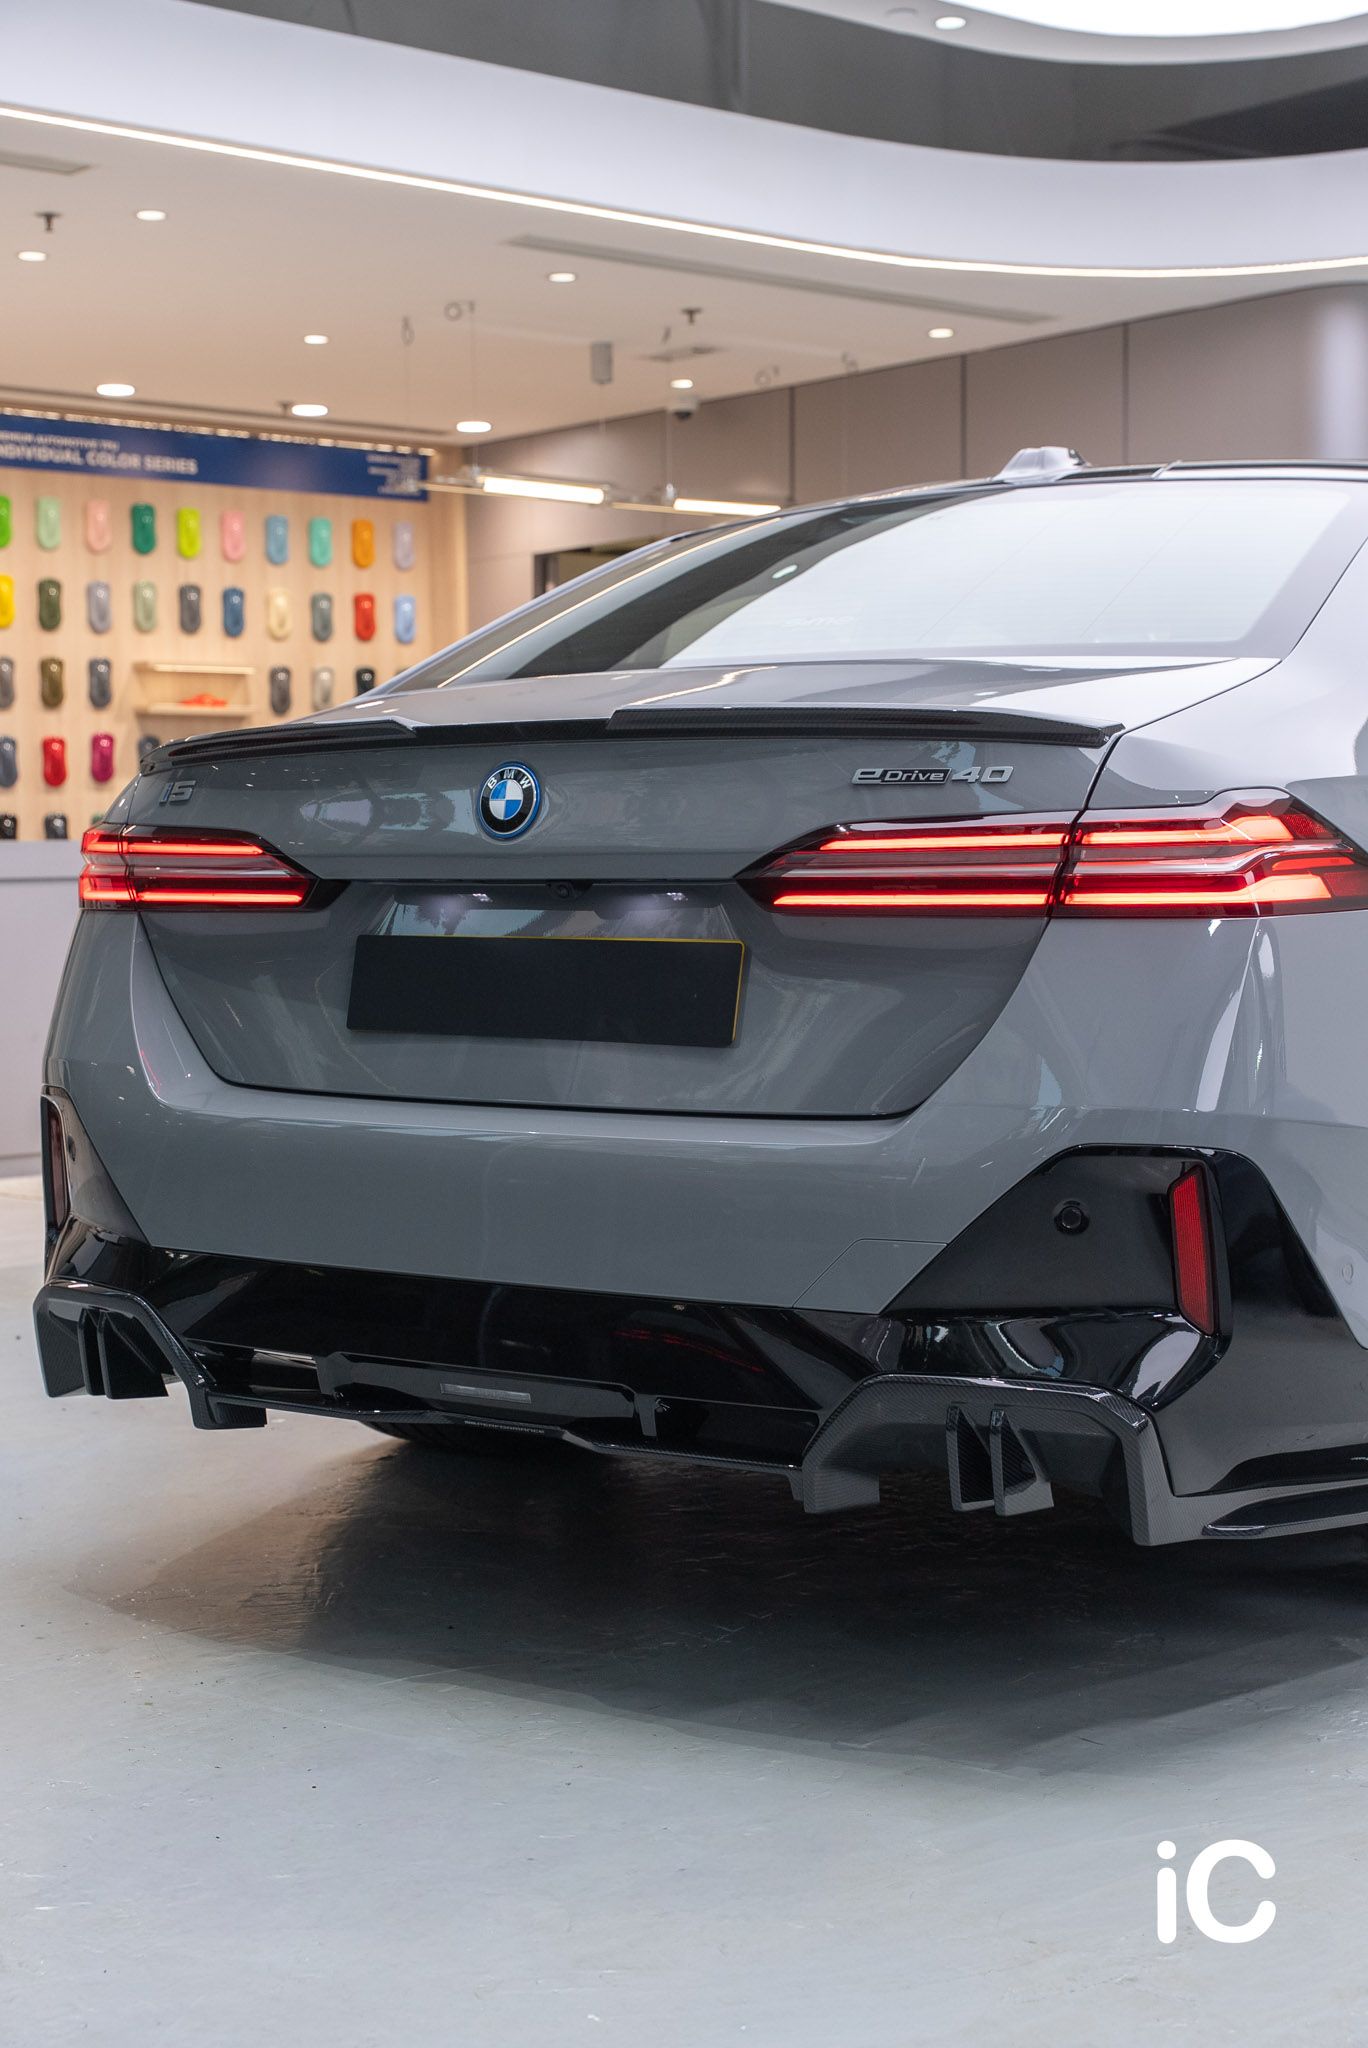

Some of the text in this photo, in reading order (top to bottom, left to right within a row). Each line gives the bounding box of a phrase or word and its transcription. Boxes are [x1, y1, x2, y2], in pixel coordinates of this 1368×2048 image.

[85, 450, 141, 471] COLOR
[143, 454, 198, 475] SERIES
[487, 769, 531, 790] BMW
[852, 766, 1014, 785] eDrive 40
